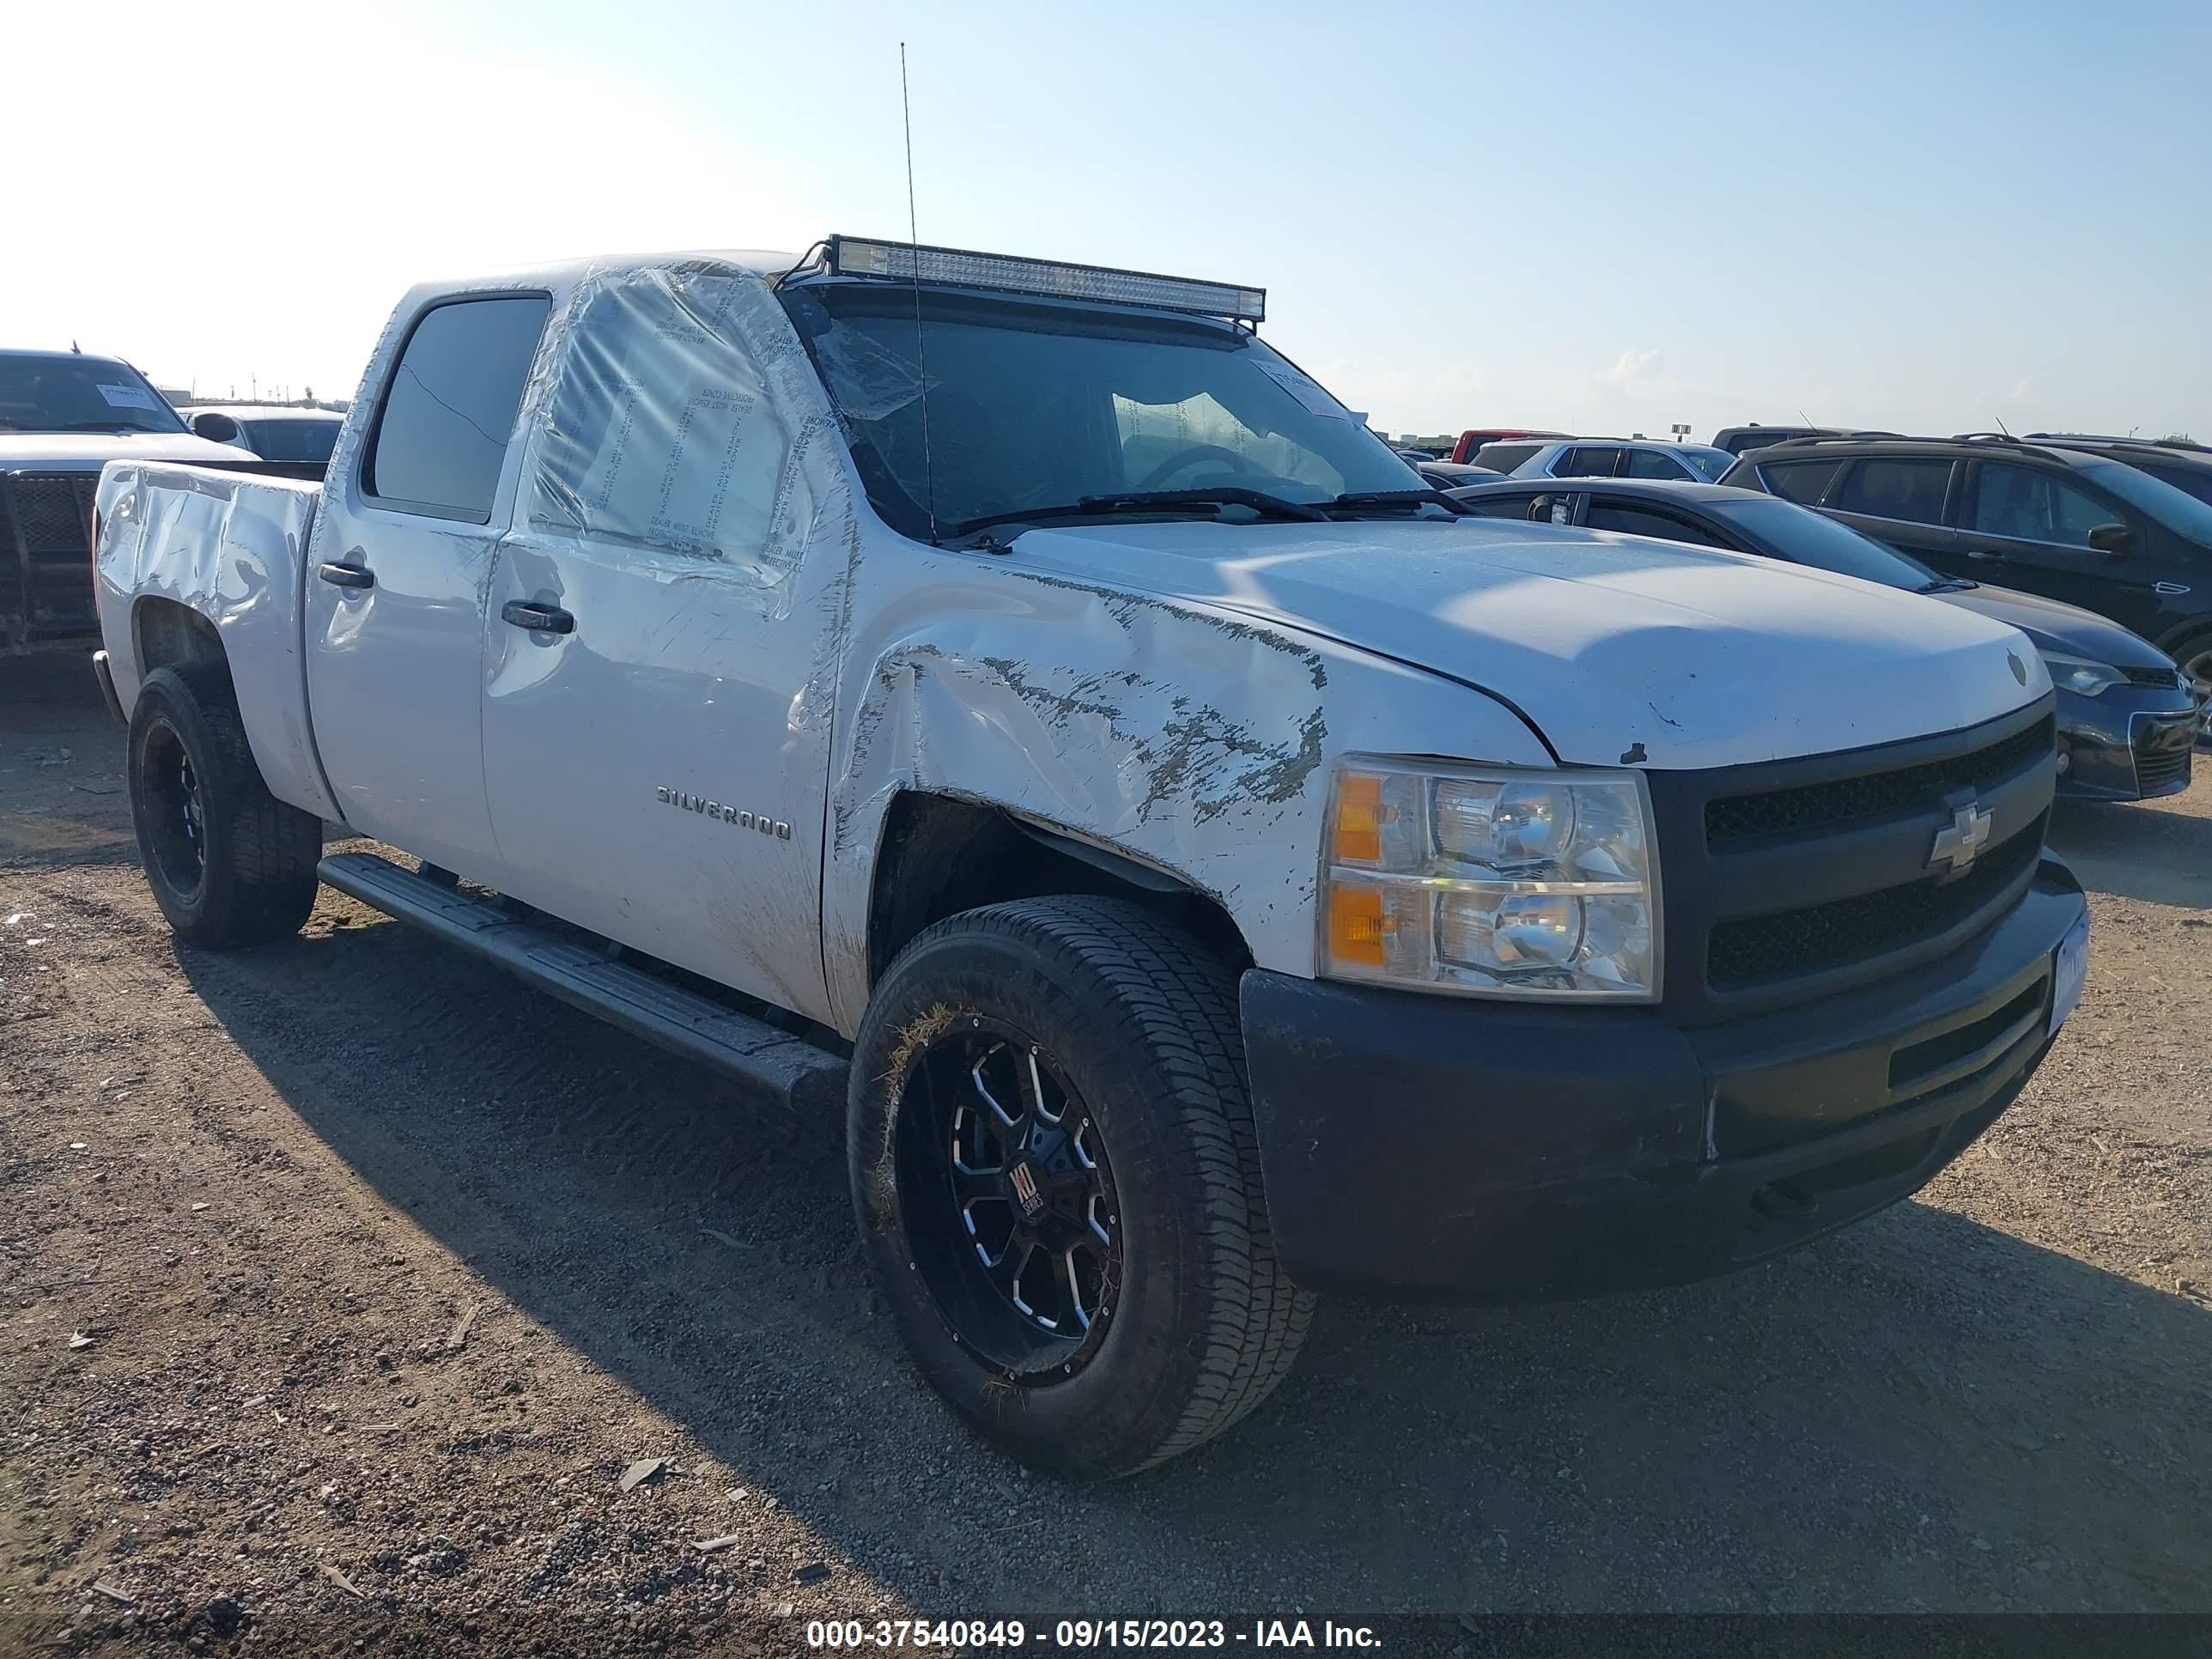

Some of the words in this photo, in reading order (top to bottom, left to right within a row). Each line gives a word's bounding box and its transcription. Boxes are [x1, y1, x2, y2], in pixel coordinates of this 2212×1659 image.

[728, 438, 743, 469] COVER
[797, 426, 816, 461] DEALER
[705, 494, 719, 528] DEALER
[716, 460, 727, 488] MUST
[786, 467, 799, 495] MUST
[657, 785, 791, 841] SILVERADO
[1022, 1192, 1044, 1216] SERIES
